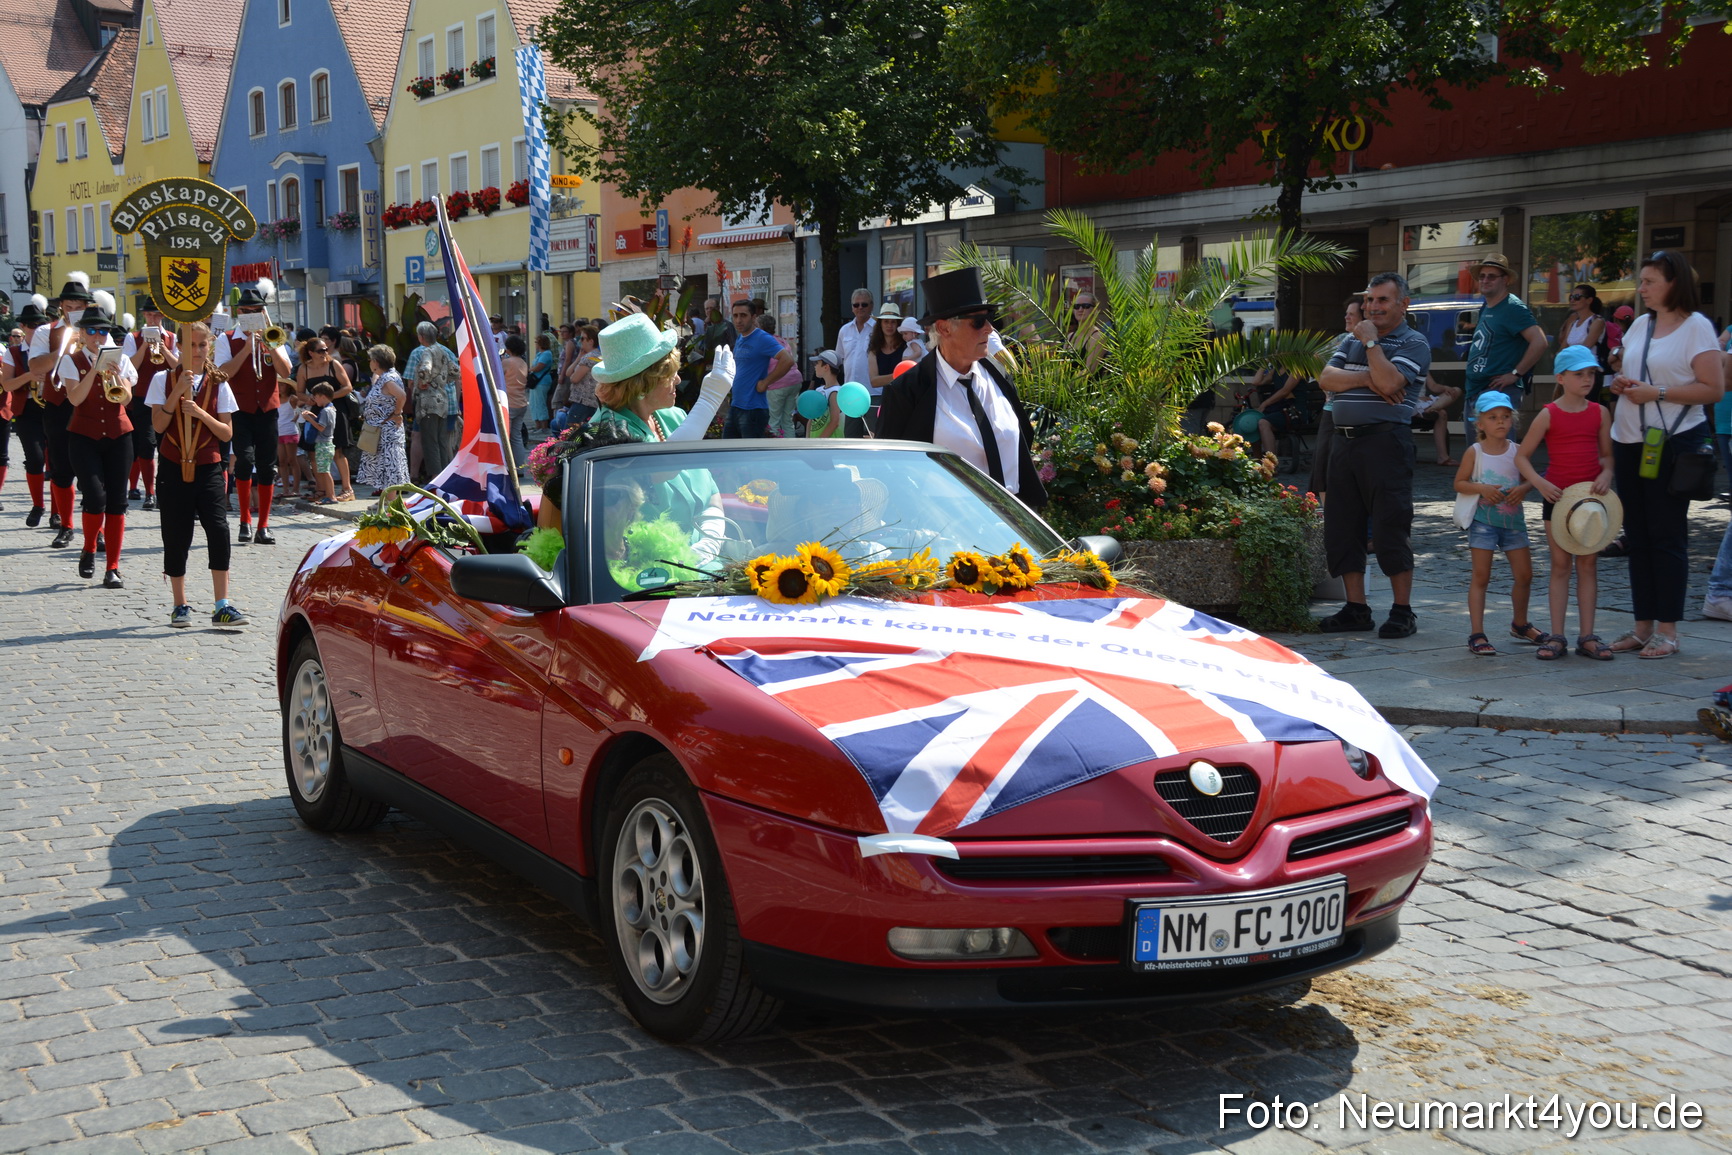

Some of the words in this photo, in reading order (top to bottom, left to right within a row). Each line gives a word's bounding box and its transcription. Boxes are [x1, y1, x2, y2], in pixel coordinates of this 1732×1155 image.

[69, 181, 92, 200] HOTEL
[551, 177, 568, 186] KINO
[113, 183, 247, 231] Blaskapelle
[141, 211, 225, 245] Pilsach
[364, 205, 378, 262] WITTL
[658, 214, 666, 242] P
[170, 236, 201, 250] 1954
[567, 238, 580, 249] KINO
[588, 217, 596, 267] KINO
[409, 259, 421, 282] P
[1472, 363, 1486, 373] ST
[687, 611, 874, 626] Neumarkt
[884, 619, 1017, 640] könnte
[1027, 634, 1091, 648] der
[1100, 643, 1224, 673] Queen
[1235, 669, 1300, 695] viel
[1162, 912, 1207, 953] NM
[1233, 906, 1272, 949] FC
[1279, 893, 1341, 943] 1900
[1141, 940, 1151, 953] D
[1144, 959, 1212, 971] Kfz-Meisterbetrieb
[1222, 956, 1249, 966] VONAU
[1278, 948, 1292, 959] Lauf
